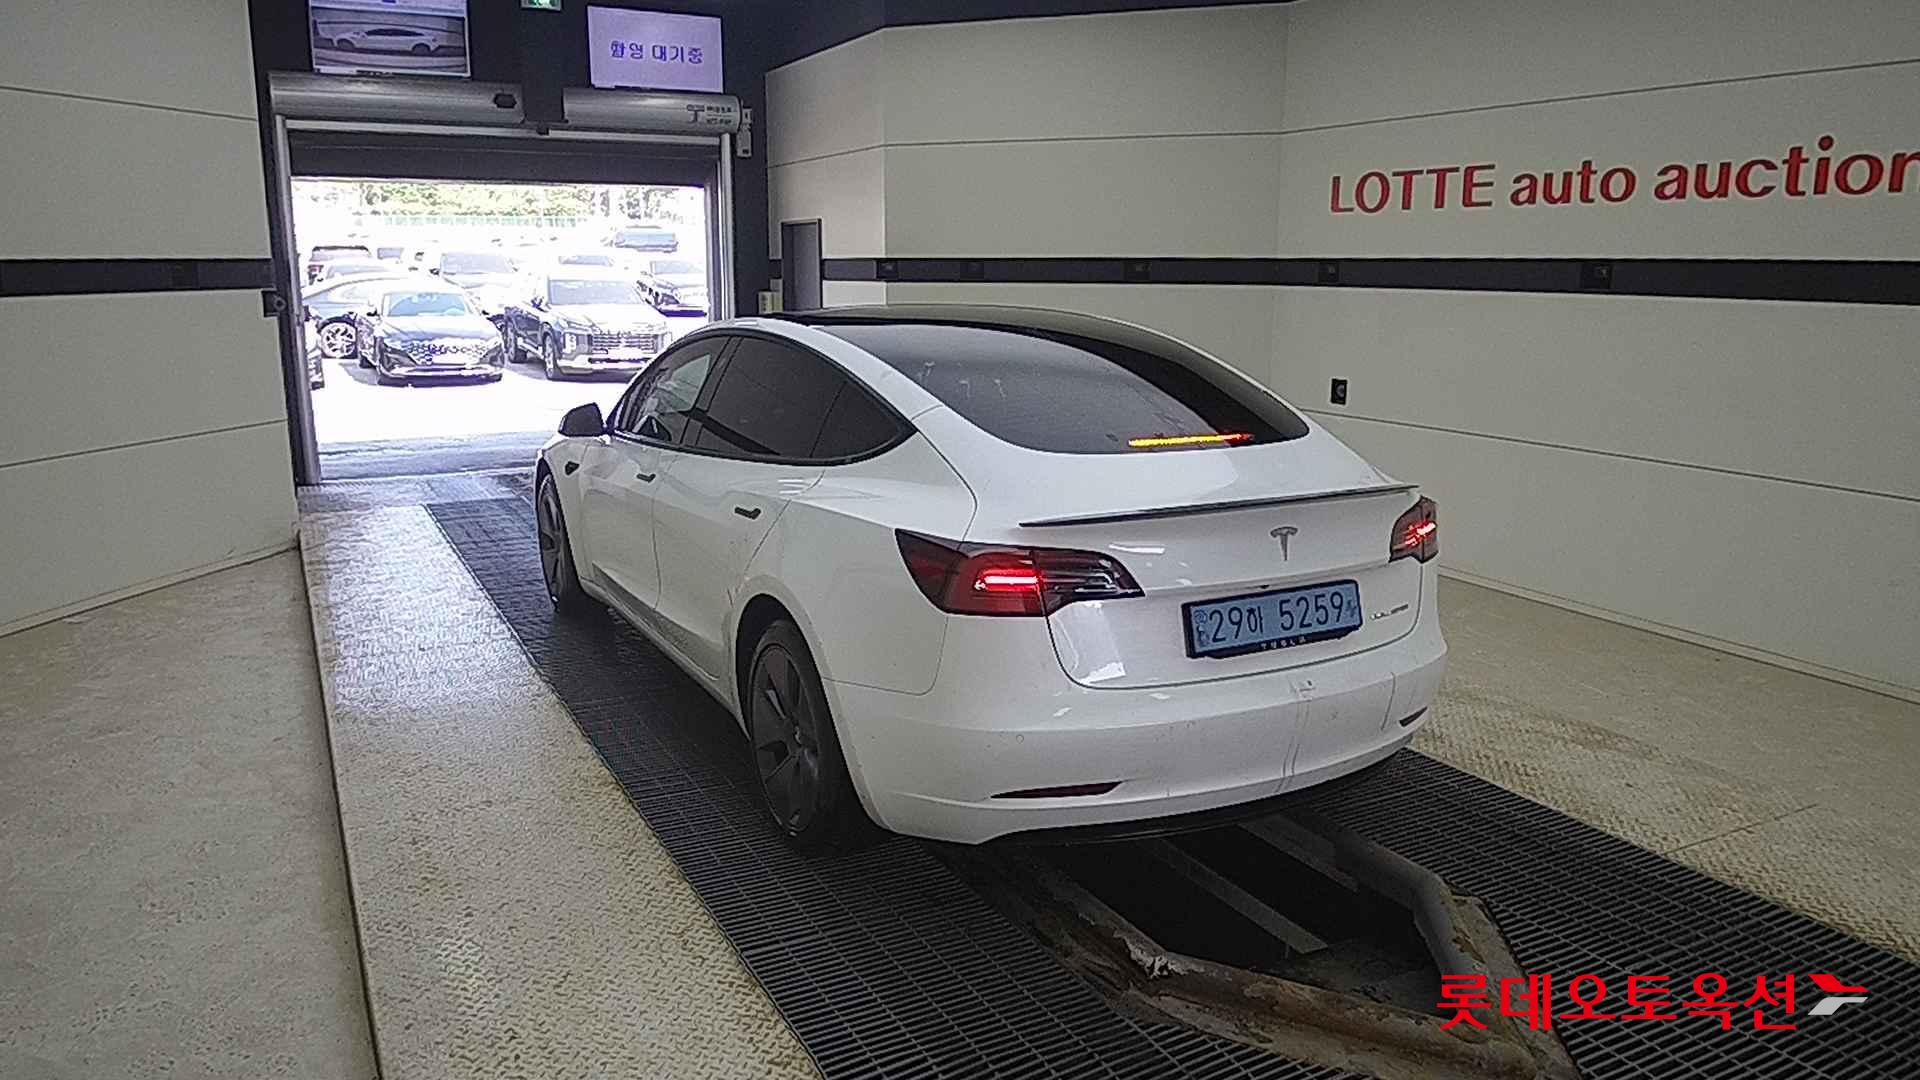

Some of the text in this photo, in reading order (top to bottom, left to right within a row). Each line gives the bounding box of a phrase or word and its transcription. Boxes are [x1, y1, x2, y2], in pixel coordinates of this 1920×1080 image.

[652, 45, 703, 64] 대기중
[1330, 164, 1496, 214] LOTTE
[1510, 160, 1636, 206] auto
[1209, 606, 1263, 643] 29하
[1279, 591, 1344, 632] 5259
